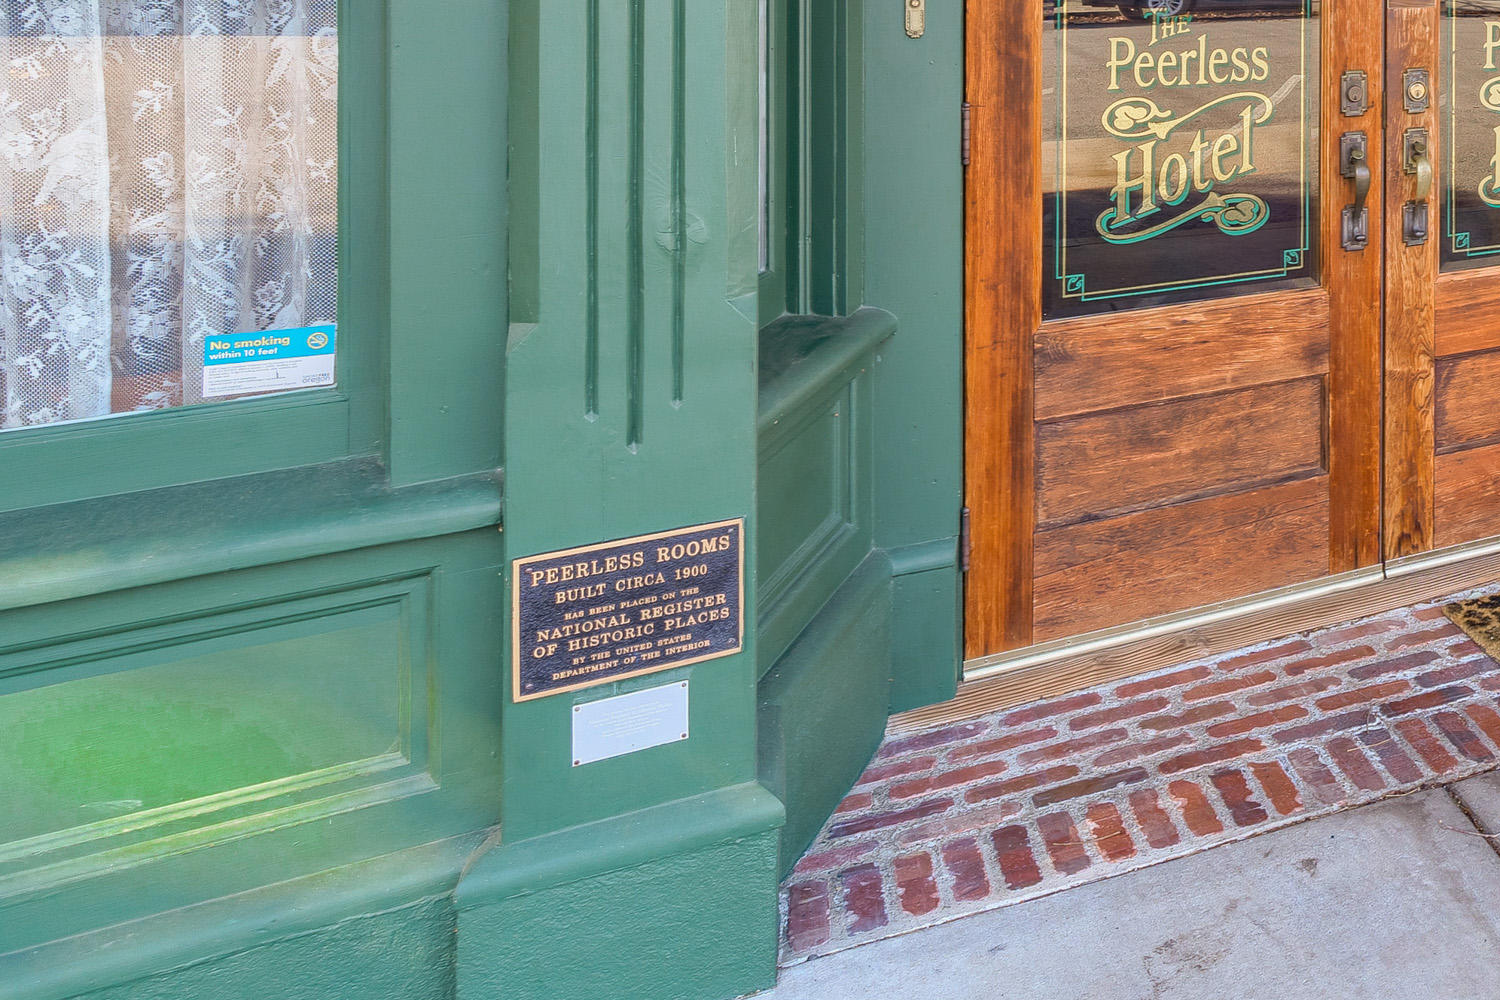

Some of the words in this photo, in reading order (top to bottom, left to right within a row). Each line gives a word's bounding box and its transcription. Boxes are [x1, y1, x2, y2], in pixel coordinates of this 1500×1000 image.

[1106, 33, 1270, 92] Peerless
[1110, 103, 1256, 226] Hotel
[209, 351, 241, 360] within
[210, 341, 230, 350] No
[234, 336, 290, 348] smoking
[531, 551, 644, 587] PEERLESS
[657, 535, 730, 563] ROOMS
[556, 583, 606, 605] BUILT
[616, 572, 666, 593] CIRCA
[675, 563, 708, 581] 1900
[565, 610, 584, 621] HAS
[589, 603, 615, 617] BEEN
[620, 595, 658, 611] PLACED
[662, 591, 676, 600] ON
[680, 587, 699, 597] THE
[533, 644, 557, 659] OF
[568, 624, 655, 652] HISTORIC
[664, 607, 731, 631] PLACES
[537, 613, 631, 643] NATIONAL
[640, 593, 727, 621] REGISTER
[552, 661, 619, 681] DEPARTMENT
[623, 654, 636, 665] OF
[641, 650, 661, 661] THE
[665, 639, 711, 656] INTERIOR
[572, 655, 586, 666] BY
[590, 651, 611, 661] THE
[616, 641, 653, 656] UNITED
[657, 634, 692, 646] STATES
